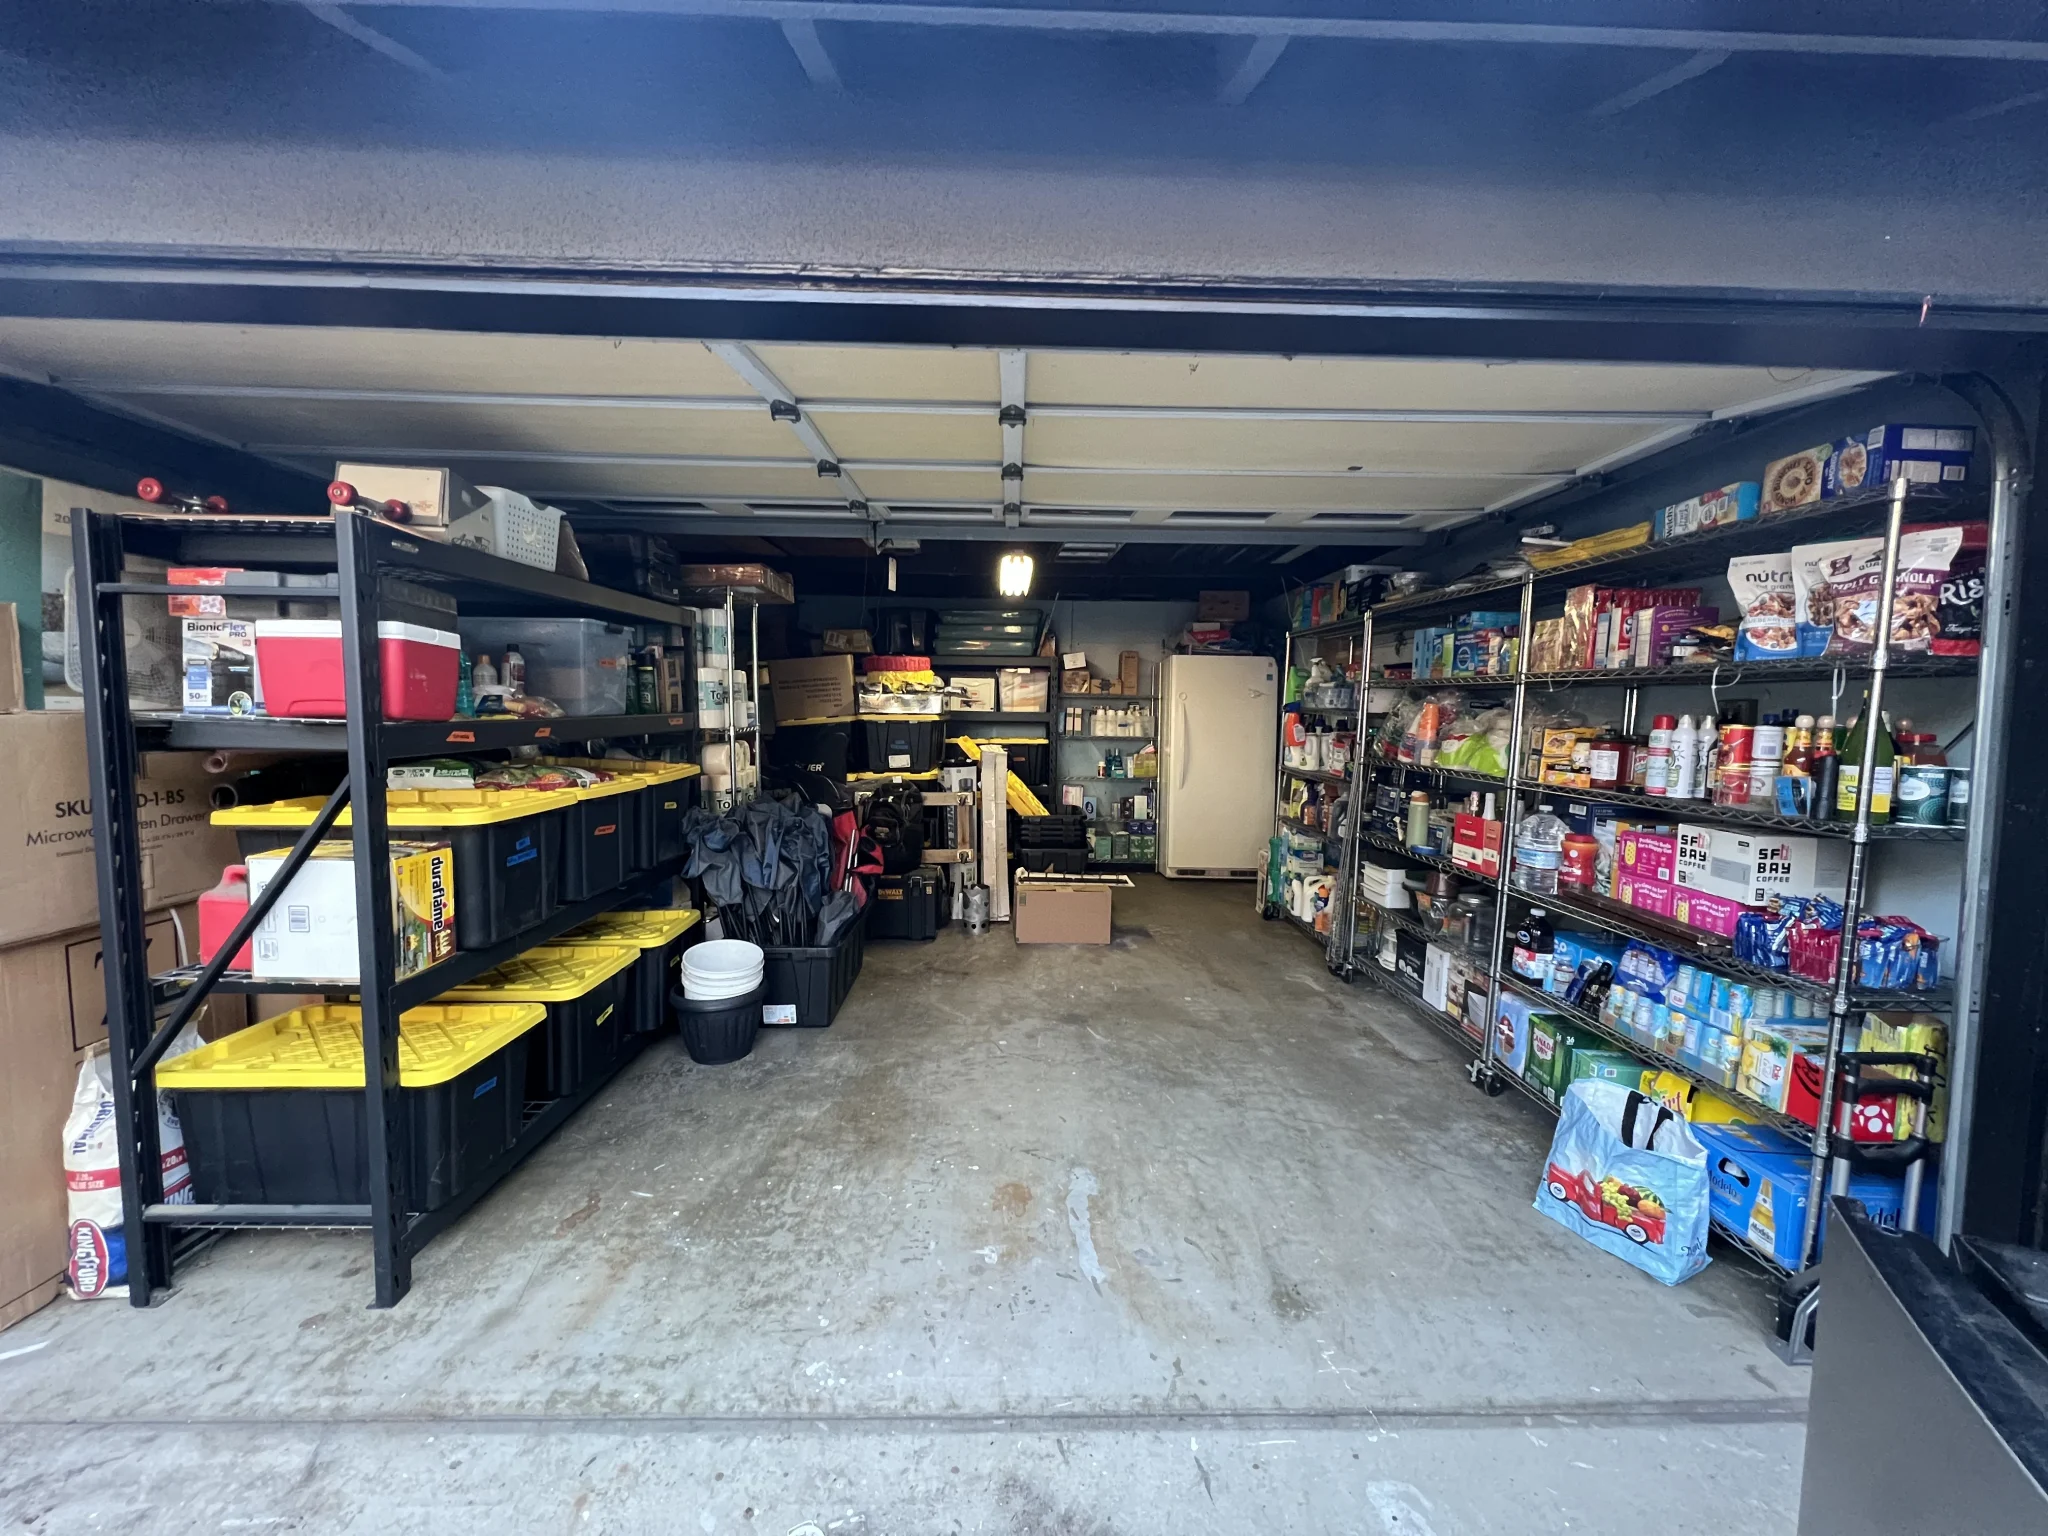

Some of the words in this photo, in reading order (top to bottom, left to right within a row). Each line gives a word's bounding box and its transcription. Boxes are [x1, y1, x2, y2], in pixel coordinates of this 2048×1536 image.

[1827, 451, 1838, 490] ALMONDS
[1666, 505, 1674, 538] Welch's
[187, 622, 246, 633] BionicFlex
[160, 809, 208, 828] Drawer
[1679, 847, 1707, 862] BAY
[1758, 848, 1781, 861] SF
[1679, 859, 1706, 871] COFFEE
[1757, 862, 1791, 875] BAY
[431, 856, 445, 931] duraflame
[1536, 1044, 1549, 1056] DRY
[1797, 1197, 1806, 1207] 2
[77, 1226, 99, 1293] KINGSFORD
